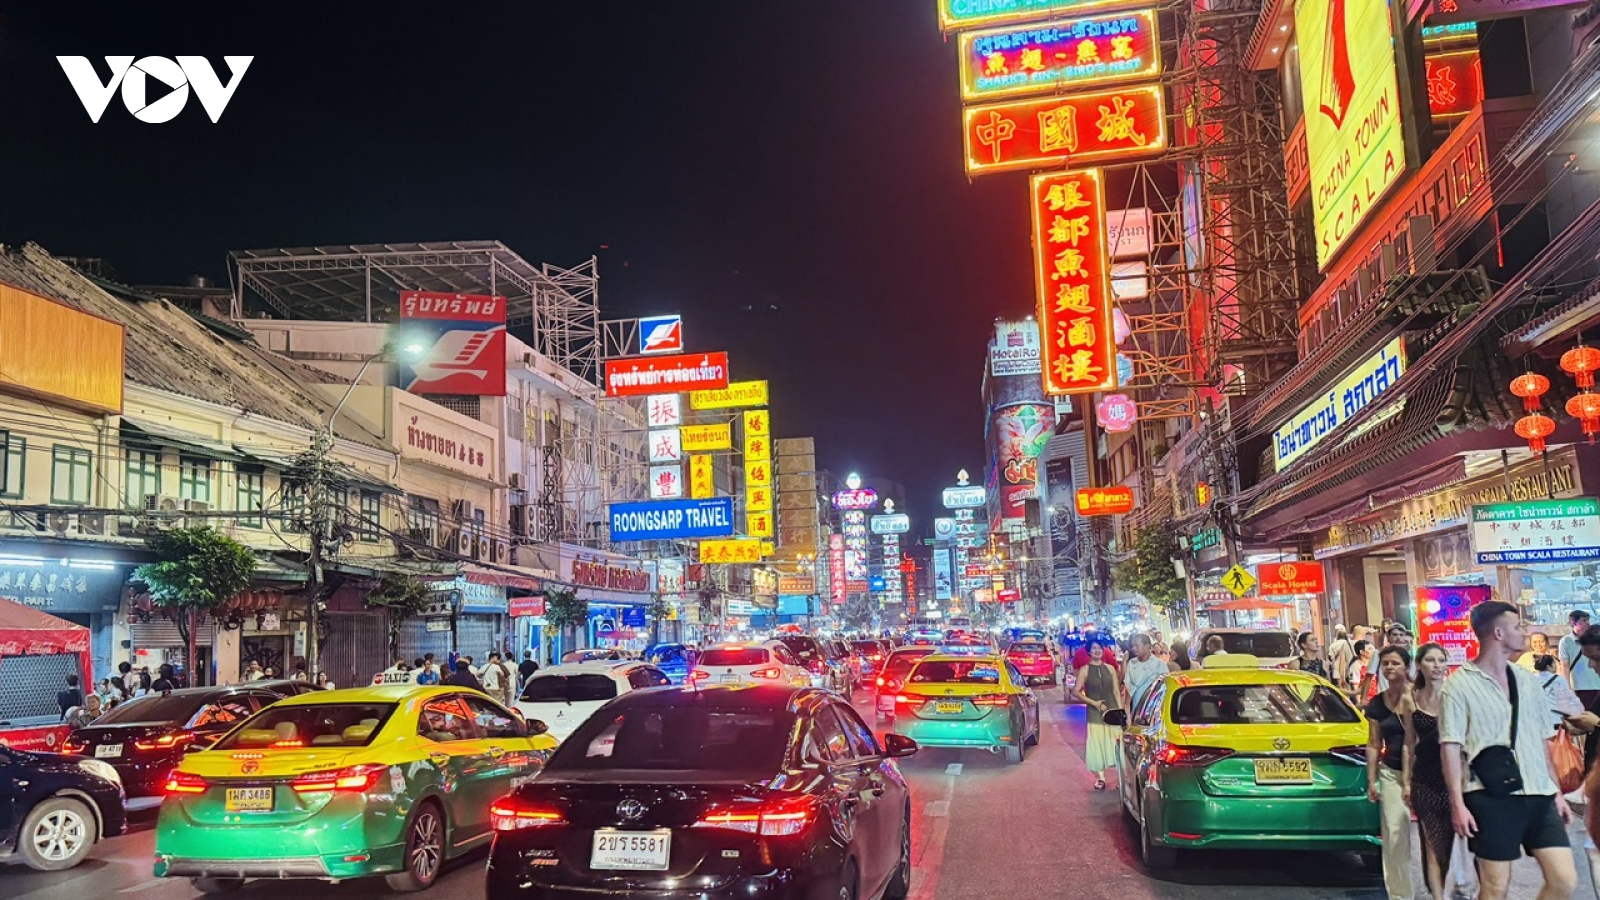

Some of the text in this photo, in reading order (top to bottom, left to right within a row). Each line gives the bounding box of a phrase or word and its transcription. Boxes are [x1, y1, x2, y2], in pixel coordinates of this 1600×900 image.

[1109, 57, 1142, 71] NEST
[975, 96, 1146, 163] 中國城
[1318, 87, 1391, 210] CHINA TOWN
[1043, 181, 1103, 383] 銀都魚翅酒樓
[404, 293, 501, 317] รุ่งทรัพย์
[609, 355, 723, 395] รุ่งทรัพย์การท่องเที่ยว
[1108, 403, 1127, 420] 媽
[1275, 350, 1400, 460] ไชน่าทาวน์ สกาล่า
[408, 415, 456, 459] ห้างขายยา
[651, 400, 678, 497] 振成豐
[613, 506, 730, 532] ROONGSARP TRAVEL
[1476, 503, 1596, 520] ภัตตาคาร ไชน่าทาวน์ สกาล่า
[1480, 547, 1600, 562] CHINA TOWN SCALA RESTAURANT
[1261, 580, 1317, 590] Scala Hostel
[383, 672, 402, 683] TAXI
[248, 789, 271, 800] 3486
[598, 836, 665, 853] 2ขร 5581
